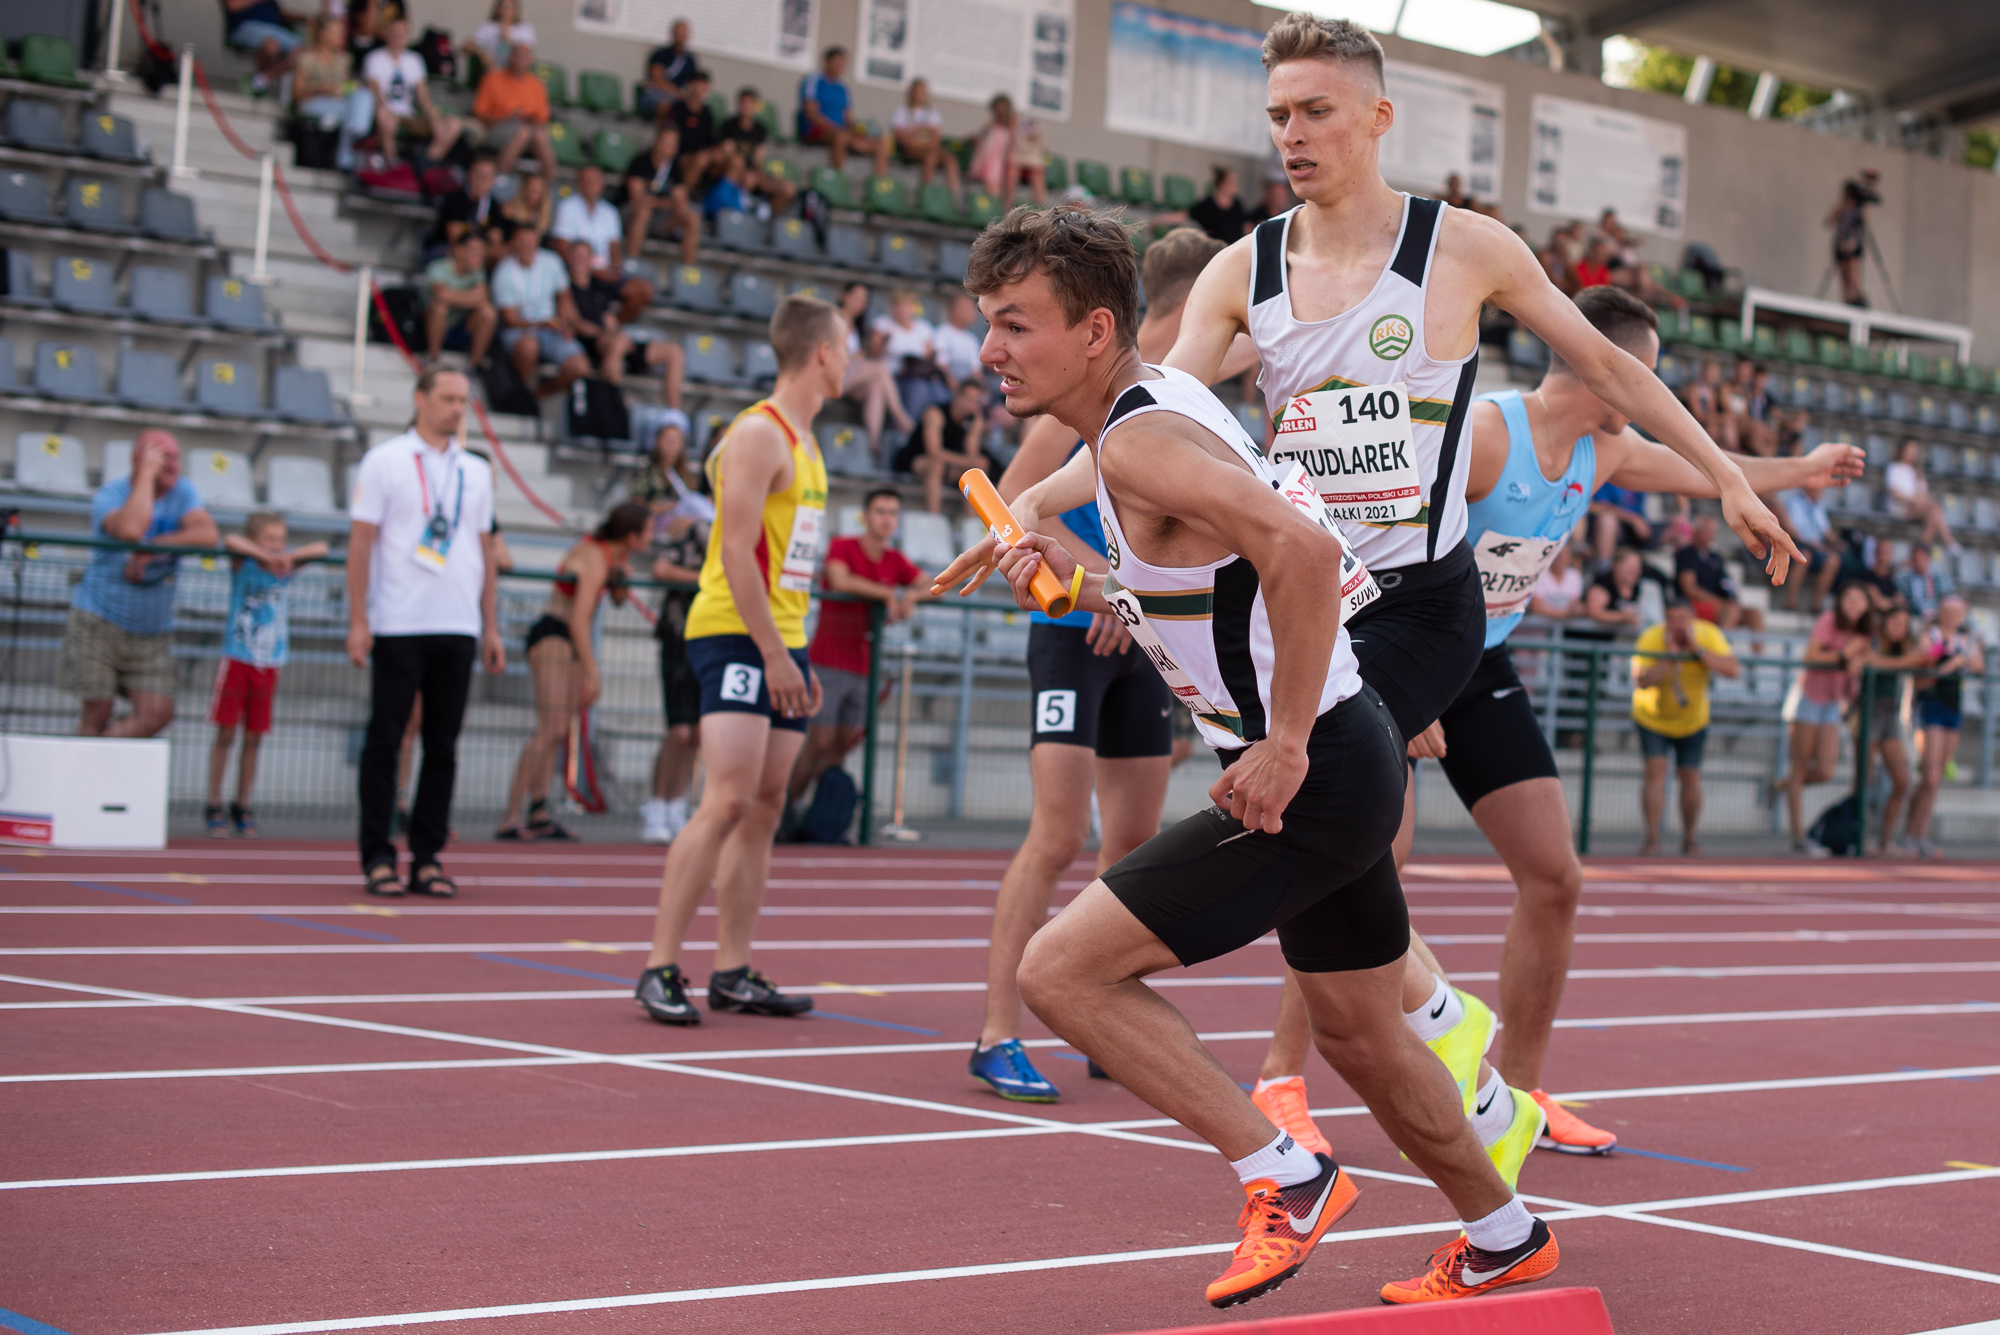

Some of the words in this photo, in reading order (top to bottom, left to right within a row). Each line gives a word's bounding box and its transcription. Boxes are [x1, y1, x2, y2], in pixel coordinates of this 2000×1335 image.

[1376, 321, 1407, 341] RKS
[1338, 390, 1400, 425] 140
[1323, 494, 1367, 502] STRZOSTWA
[1369, 491, 1396, 500] POLSKI
[1397, 489, 1415, 497] U23
[1332, 507, 1362, 520] AŁKI
[1365, 505, 1396, 519] 2021
[731, 669, 751, 696] 3
[1044, 695, 1065, 726] 5
